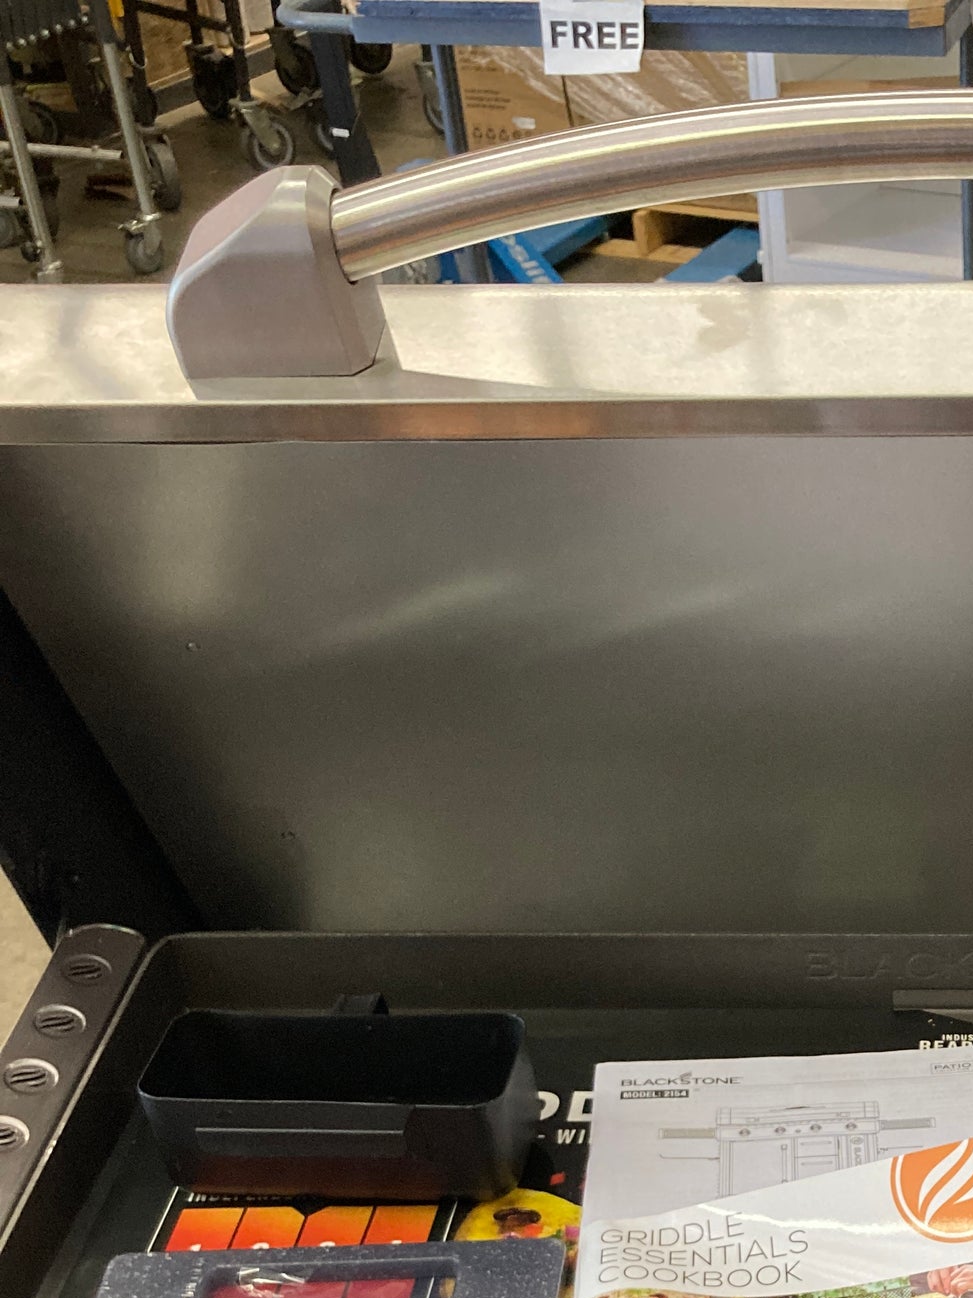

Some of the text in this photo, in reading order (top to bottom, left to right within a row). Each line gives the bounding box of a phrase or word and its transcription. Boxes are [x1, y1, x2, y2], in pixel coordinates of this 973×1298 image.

[550, 21, 640, 49] FREE
[933, 1062, 972, 1071] PATIO
[620, 1075, 741, 1087] BLACKSTONE
[622, 1090, 662, 1099] MODEL:
[600, 1211, 745, 1247] GRIDDLE
[600, 1229, 809, 1267] ESSENTIALS
[598, 1260, 804, 1288] COOKBOOK
